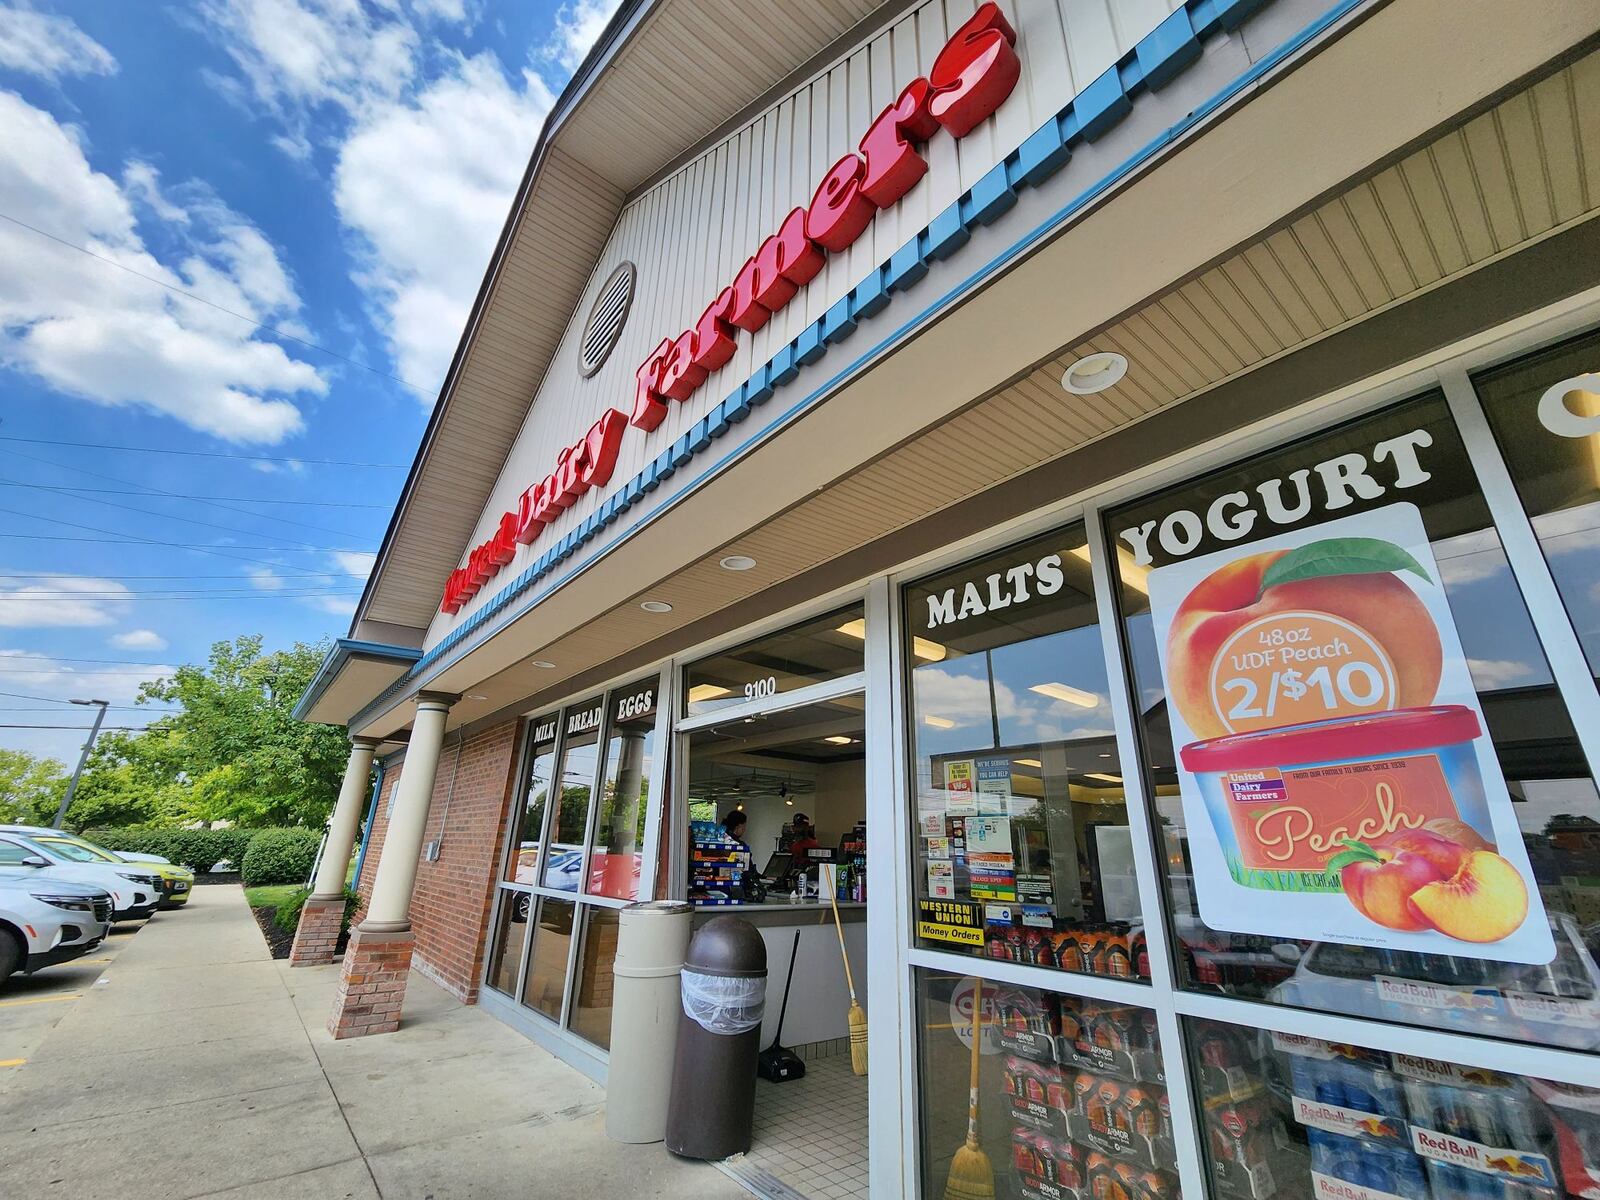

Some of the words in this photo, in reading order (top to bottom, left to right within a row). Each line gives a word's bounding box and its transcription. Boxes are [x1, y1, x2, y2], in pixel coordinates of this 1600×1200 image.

[515, 408, 629, 546] Dairy
[630, 2, 1021, 432] Farmers
[1119, 429, 1433, 567] YOGURT
[926, 554, 1064, 629] MALTS
[1231, 649, 1276, 671] UDF
[1279, 638, 1352, 664] Peach
[744, 676, 776, 702] 9100
[1222, 661, 1385, 720] 2/$10
[617, 690, 653, 720] EGGS
[568, 707, 600, 734] BREAD
[534, 721, 555, 743] MILK
[1229, 771, 1265, 782] United
[1293, 772, 1309, 780] FROM
[1310, 770, 1321, 778] OUR
[1322, 768, 1343, 777] FAMILY
[1344, 766, 1352, 774] TO
[1233, 782, 1261, 792] Dairy
[1235, 792, 1279, 801] Farmers
[1255, 782, 1425, 861] Peach
[920, 901, 971, 914] WESTERN
[935, 912, 971, 925] UNION
[922, 925, 949, 938] Money
[951, 929, 980, 941] Orders
[1381, 980, 1408, 995] Red
[1409, 984, 1438, 999] Bull
[1398, 1053, 1425, 1069] Red
[1426, 1058, 1453, 1076] Bull
[1301, 1103, 1322, 1118] Red
[1322, 1109, 1345, 1121] Bull
[1418, 1132, 1447, 1150] Red
[1449, 1139, 1479, 1159] Bull
[1320, 1179, 1343, 1195] Red
[1344, 1187, 1368, 1200] Bull
